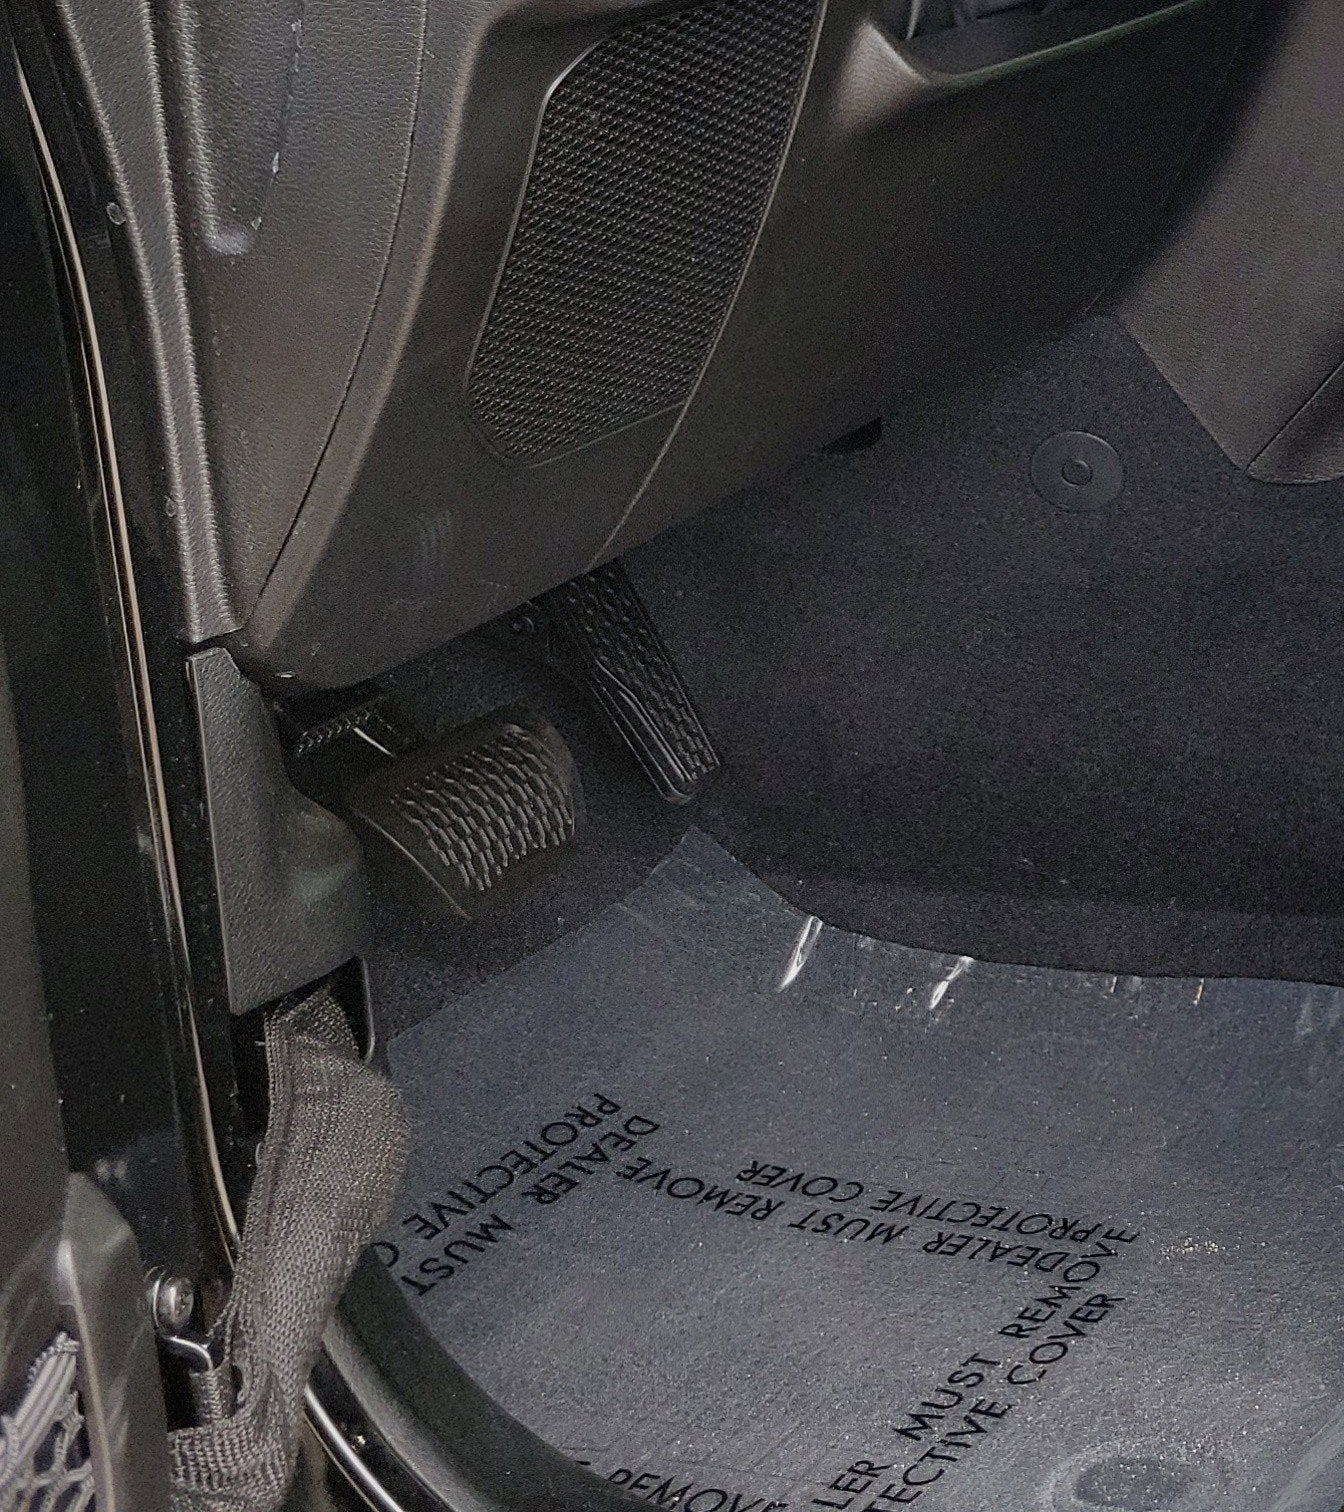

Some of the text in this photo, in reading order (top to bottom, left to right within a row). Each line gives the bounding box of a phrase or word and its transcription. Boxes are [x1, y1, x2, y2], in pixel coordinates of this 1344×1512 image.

[401, 1092, 622, 1240] PROTECTIVE
[401, 1114, 661, 1297] DEALER MUST
[616, 1156, 1071, 1273] DEALER MUST REMOVE
[736, 1160, 1103, 1244] PROTECTIVE COVER
[811, 1227, 1140, 1510] LER MUST REMOVE
[862, 1293, 1126, 1512] TECTIVE COVER
